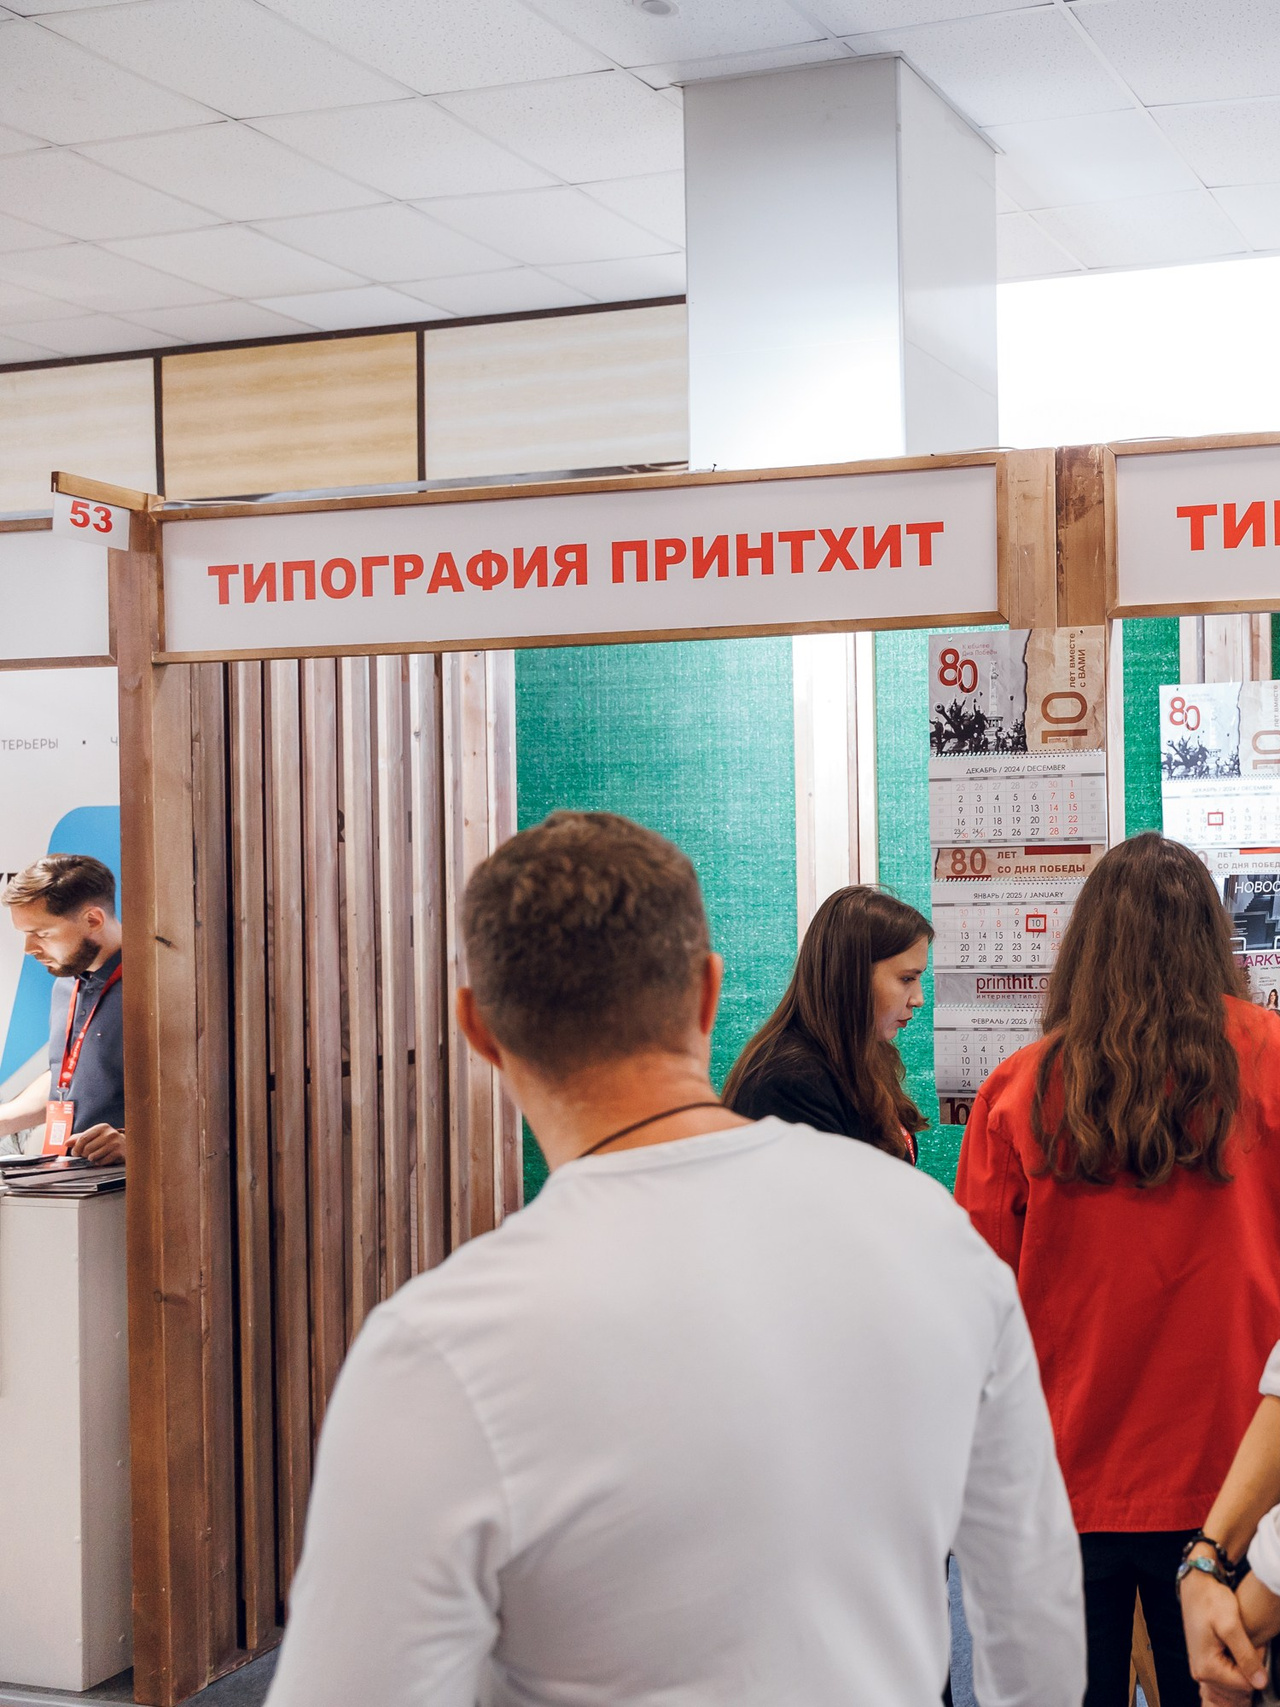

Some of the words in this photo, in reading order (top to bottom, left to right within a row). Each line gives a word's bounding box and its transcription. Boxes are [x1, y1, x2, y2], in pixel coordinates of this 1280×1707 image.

[70, 500, 112, 533] 53
[207, 543, 589, 605] ТИПОГРАФИЯ
[611, 521, 944, 584] ПРИНТХИТ
[1078, 650, 1086, 678] ВАМИ
[938, 648, 978, 693] 80
[1170, 697, 1200, 731] 80
[966, 766, 997, 774] ДЕКАБРЬ
[1030, 781, 1038, 789] 29
[1070, 780, 1073, 788] 1
[958, 795, 963, 803] 2
[975, 806, 983, 814] 10
[993, 805, 1001, 813] 11
[957, 818, 965, 826] 16
[993, 817, 1002, 825] 18
[1068, 815, 1078, 823] 22
[1069, 827, 1078, 835] 29
[997, 851, 1017, 859] ЛЕТ
[951, 848, 986, 875] 80
[998, 866, 1011, 874] СО
[1015, 865, 1036, 874] ДНЯ
[1040, 865, 1085, 873] ПОБЕДЫ
[977, 975, 1048, 993] printhit.o
